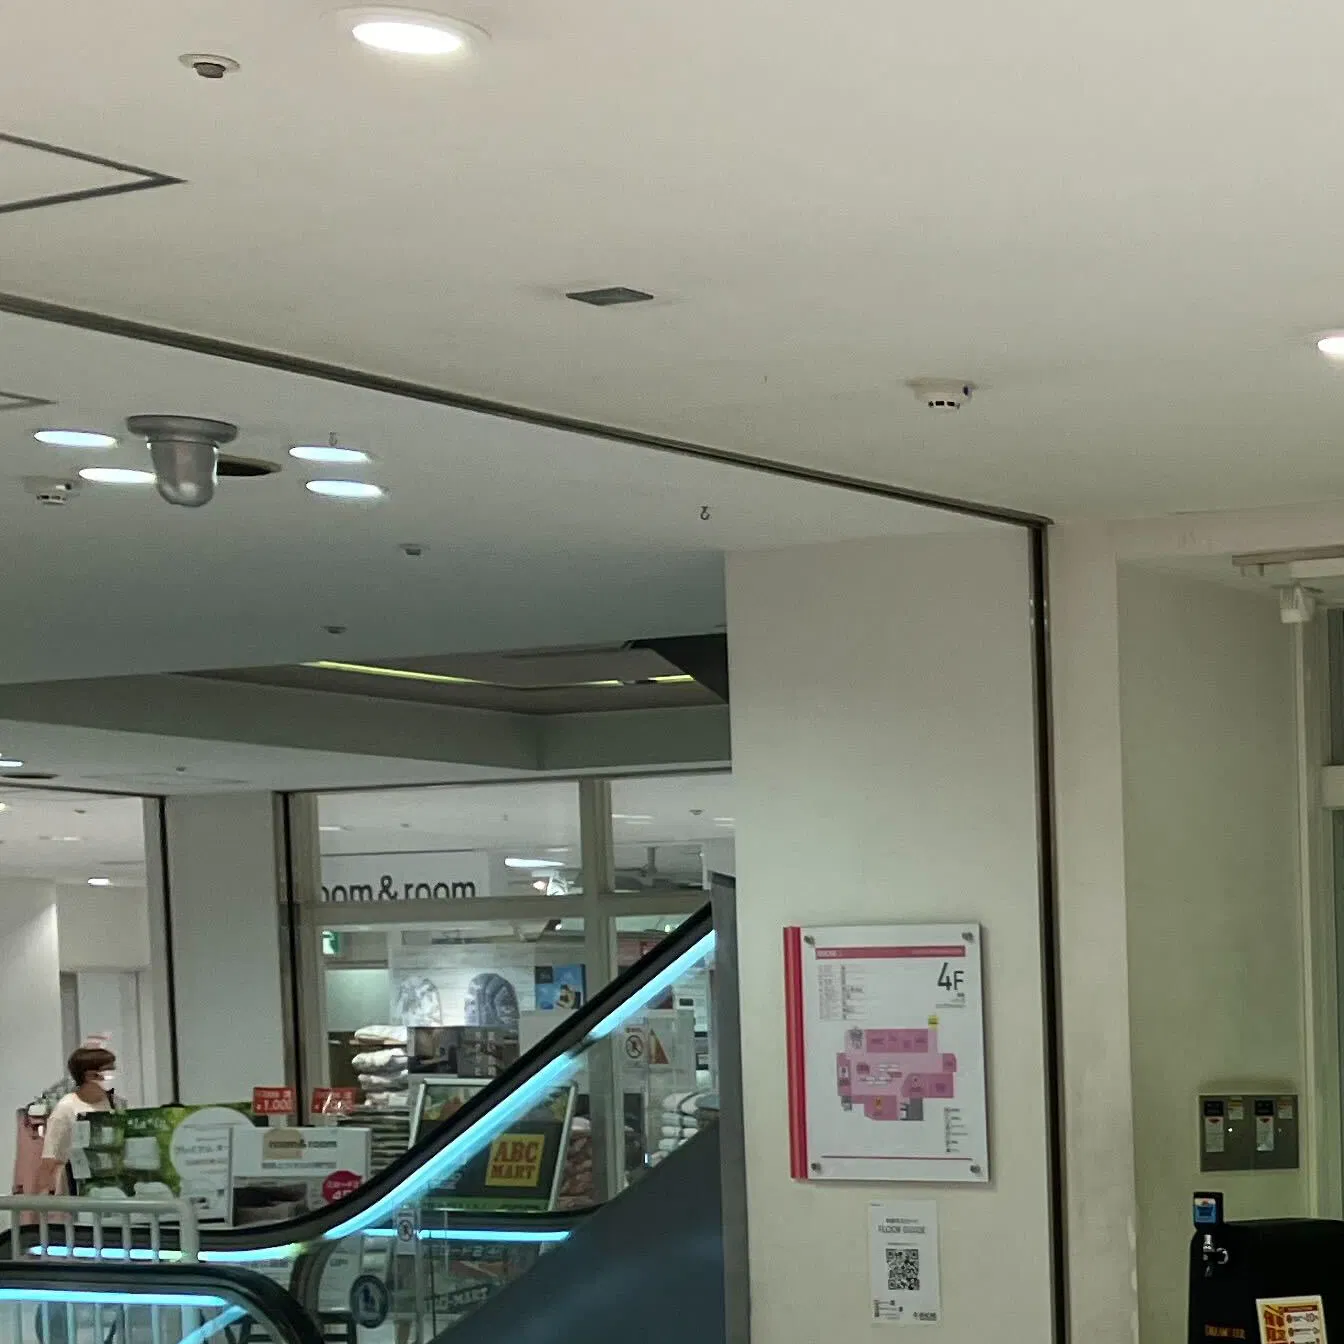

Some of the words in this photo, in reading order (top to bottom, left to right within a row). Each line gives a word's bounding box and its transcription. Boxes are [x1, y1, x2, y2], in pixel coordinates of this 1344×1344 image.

[937, 962, 965, 991] 4F
[493, 1141, 540, 1163] ABC
[490, 1164, 536, 1180] MART
